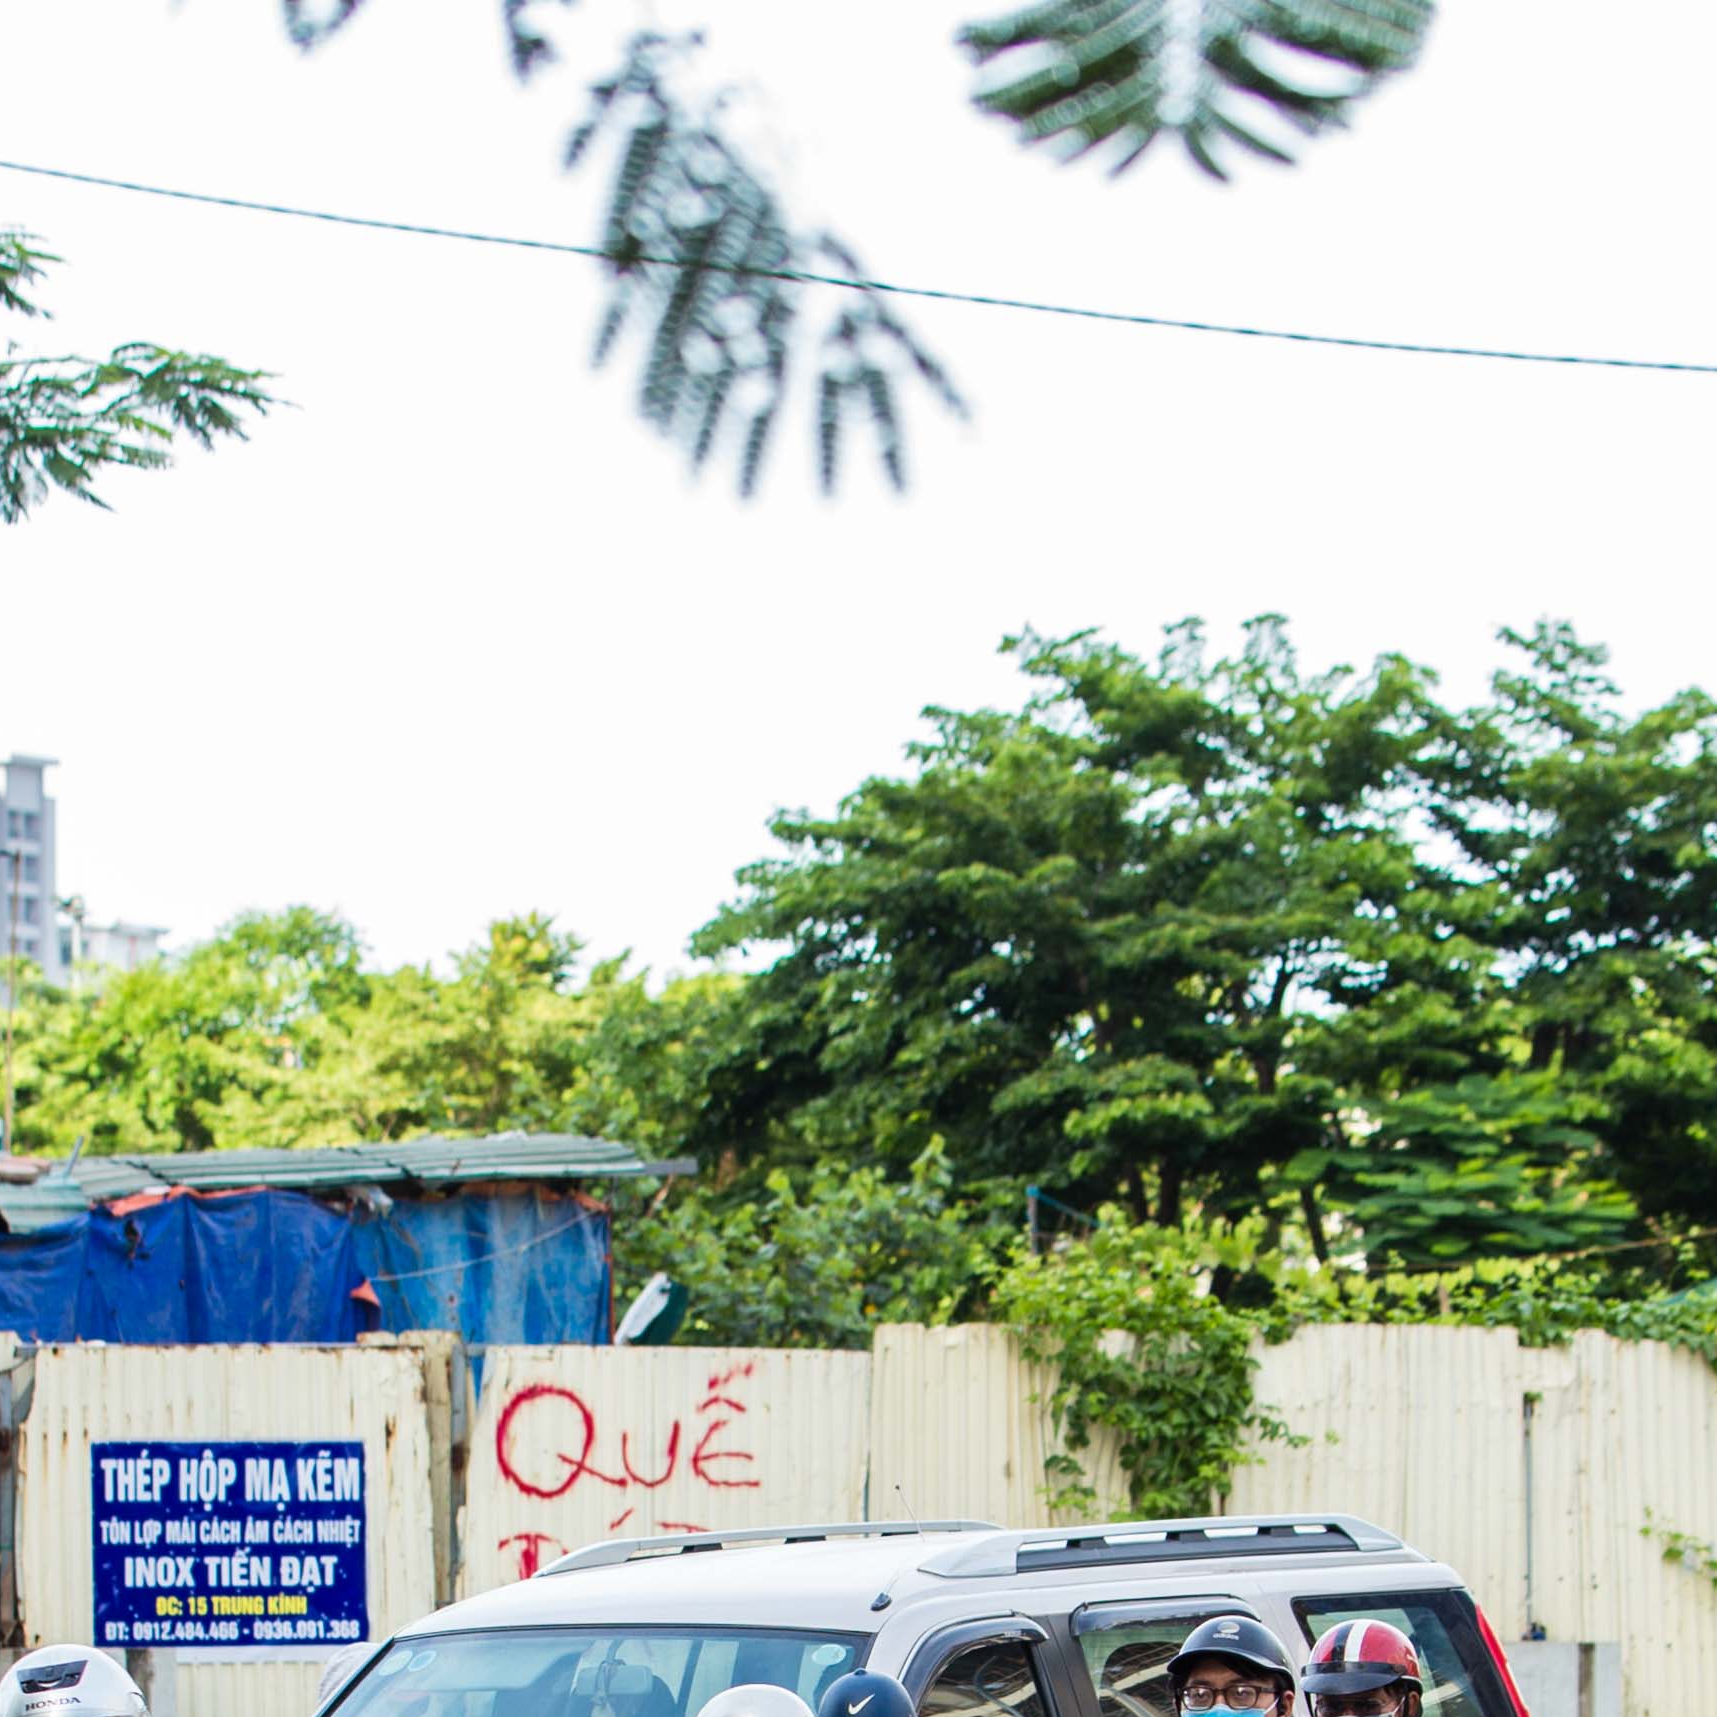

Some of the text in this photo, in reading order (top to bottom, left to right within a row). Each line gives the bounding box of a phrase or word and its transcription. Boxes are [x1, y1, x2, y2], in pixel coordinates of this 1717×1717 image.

[99, 1449, 360, 1512] THÉP HỘP MẠ KẼM
[100, 1516, 131, 1545] TÔN
[134, 1519, 163, 1550] LỢP
[165, 1516, 197, 1545] MÁI
[199, 1516, 242, 1545] CÁCH
[272, 1516, 314, 1545] CÁCH
[316, 1515, 361, 1549] NHIỆT
[124, 1546, 338, 1593] INOX TIẾN ĐẠT
[155, 1592, 308, 1616] ĐC: 15 TRUNG KÍNH
[25, 1697, 81, 1711] HONDA
